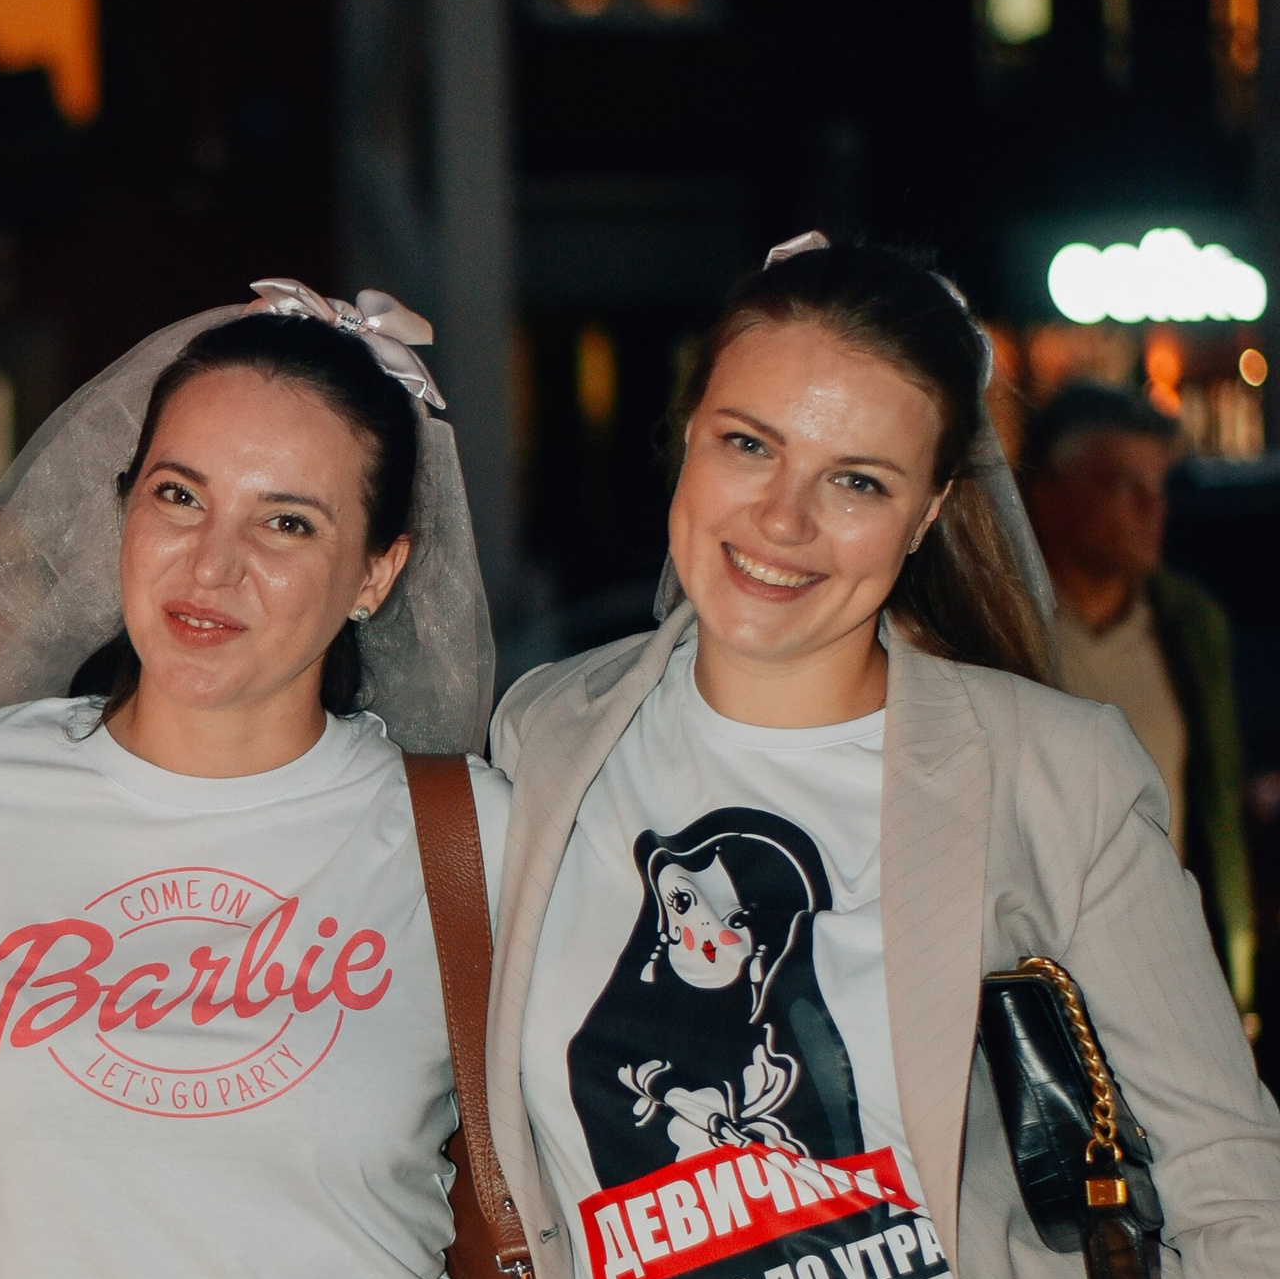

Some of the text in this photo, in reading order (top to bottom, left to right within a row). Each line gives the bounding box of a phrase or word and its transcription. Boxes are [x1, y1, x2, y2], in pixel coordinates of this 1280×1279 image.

[120, 879, 252, 921] COME ON
[85, 1043, 303, 1109] LET'S GO PARTY
